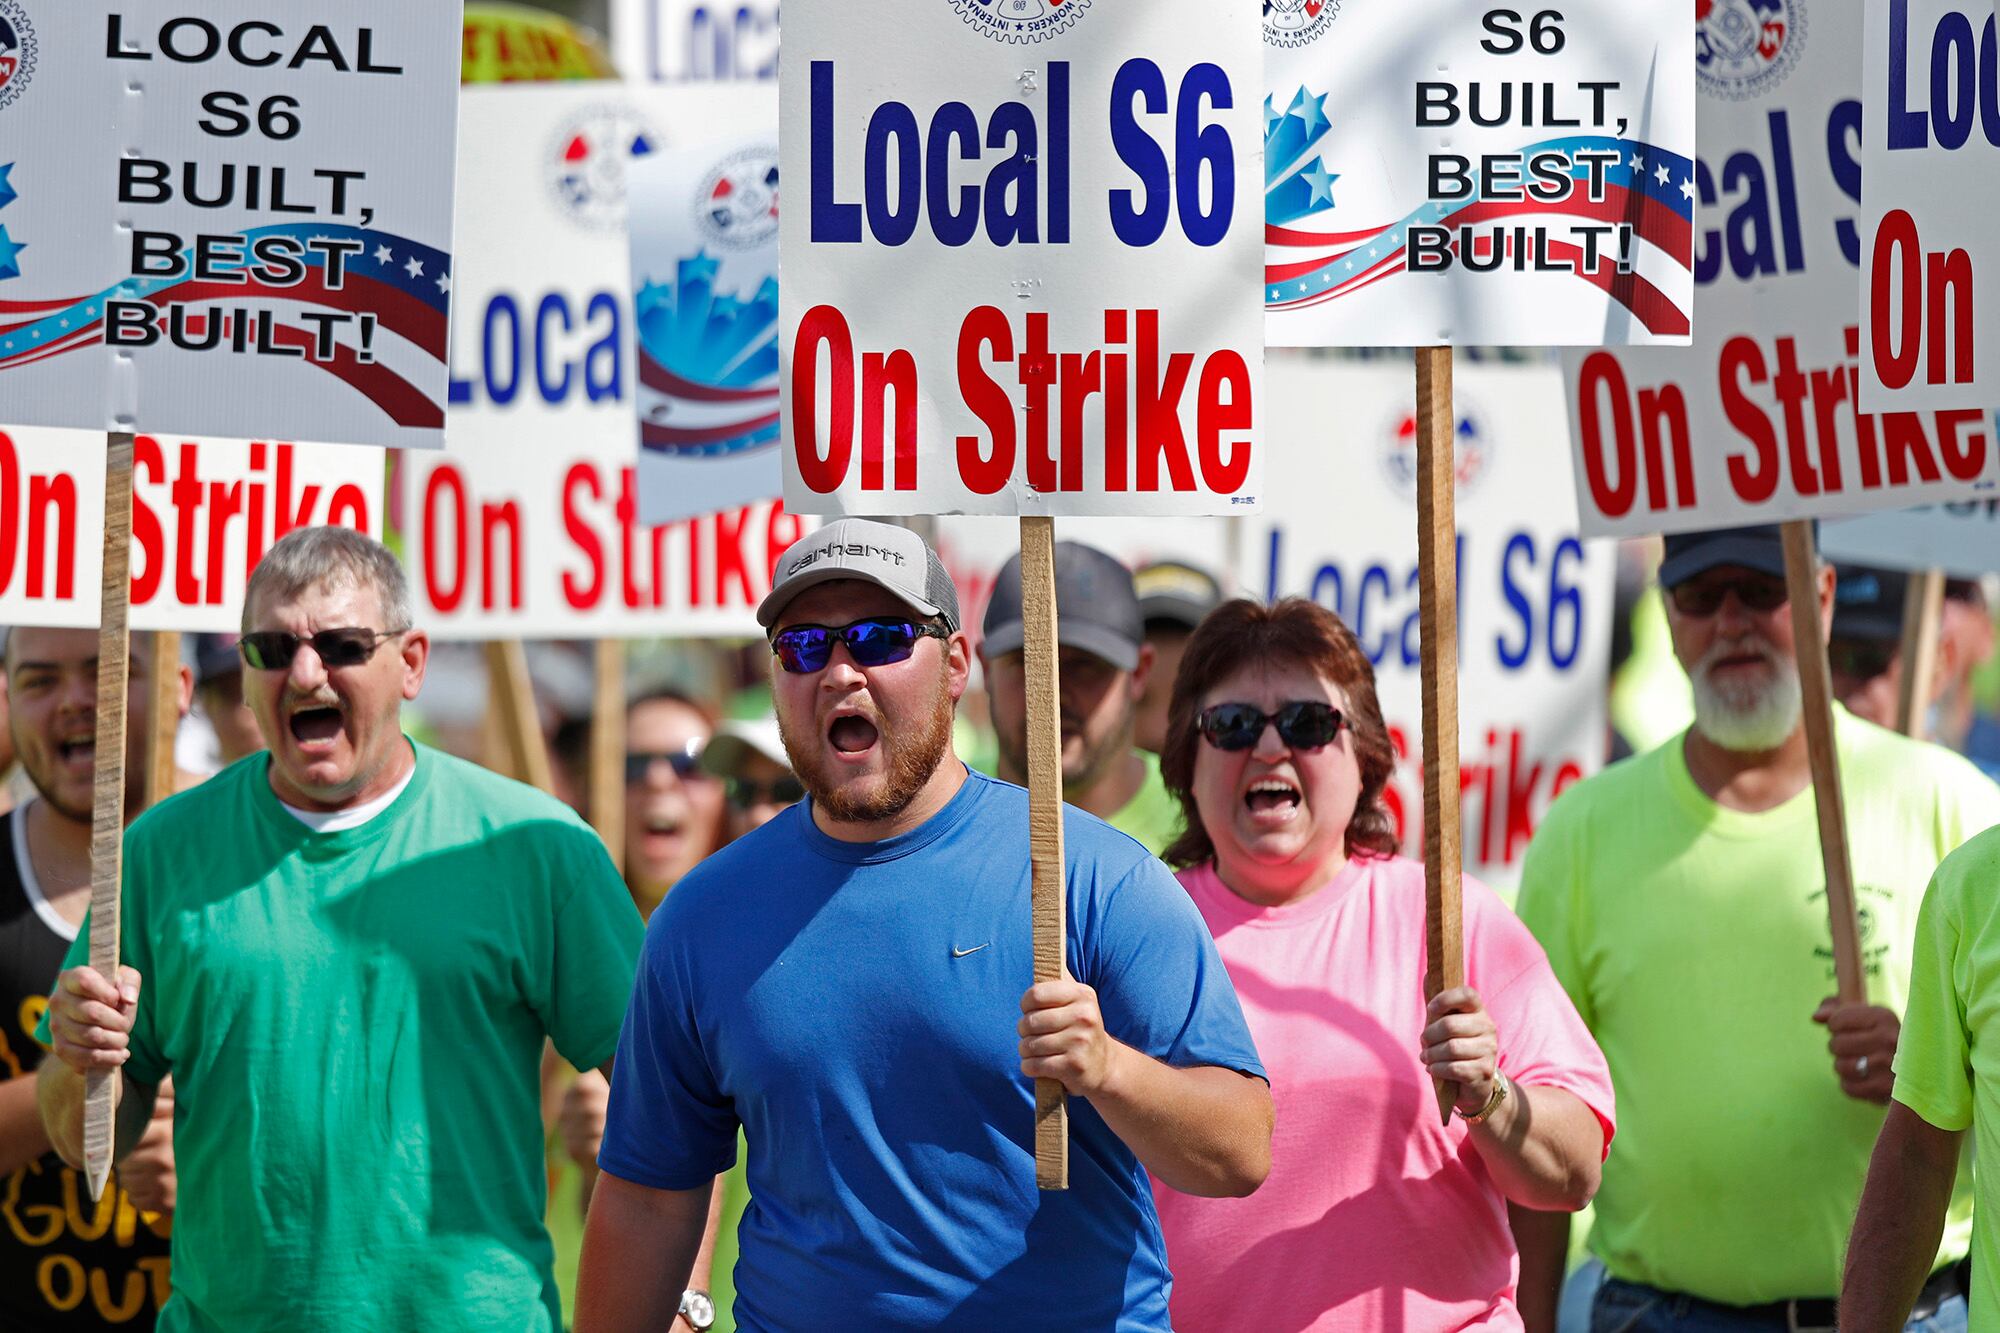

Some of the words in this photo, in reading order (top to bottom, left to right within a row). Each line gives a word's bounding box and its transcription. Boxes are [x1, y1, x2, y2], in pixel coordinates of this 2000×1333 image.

[1013, 1, 1027, 10] OF
[1028, 2, 1075, 32] WORKERS
[1480, 9, 1566, 54] S6
[107, 14, 403, 74] LOCAL
[198, 92, 301, 140] S6
[1416, 82, 1628, 136] BUILT,
[810, 61, 1070, 247] Local
[1109, 57, 1235, 247] S6
[1428, 154, 1618, 200] BEST
[118, 158, 374, 225] BUILT,
[131, 231, 362, 290] BEST
[1407, 226, 1633, 273] BUILT!
[1871, 209, 1974, 389] On
[105, 301, 377, 361] BUILT!
[792, 304, 918, 494] On
[956, 304, 1253, 496] Strike
[1578, 352, 1696, 519] On
[424, 465, 520, 612] On
[788, 542, 905, 575] carhartt
[1496, 533, 1585, 670] S6
